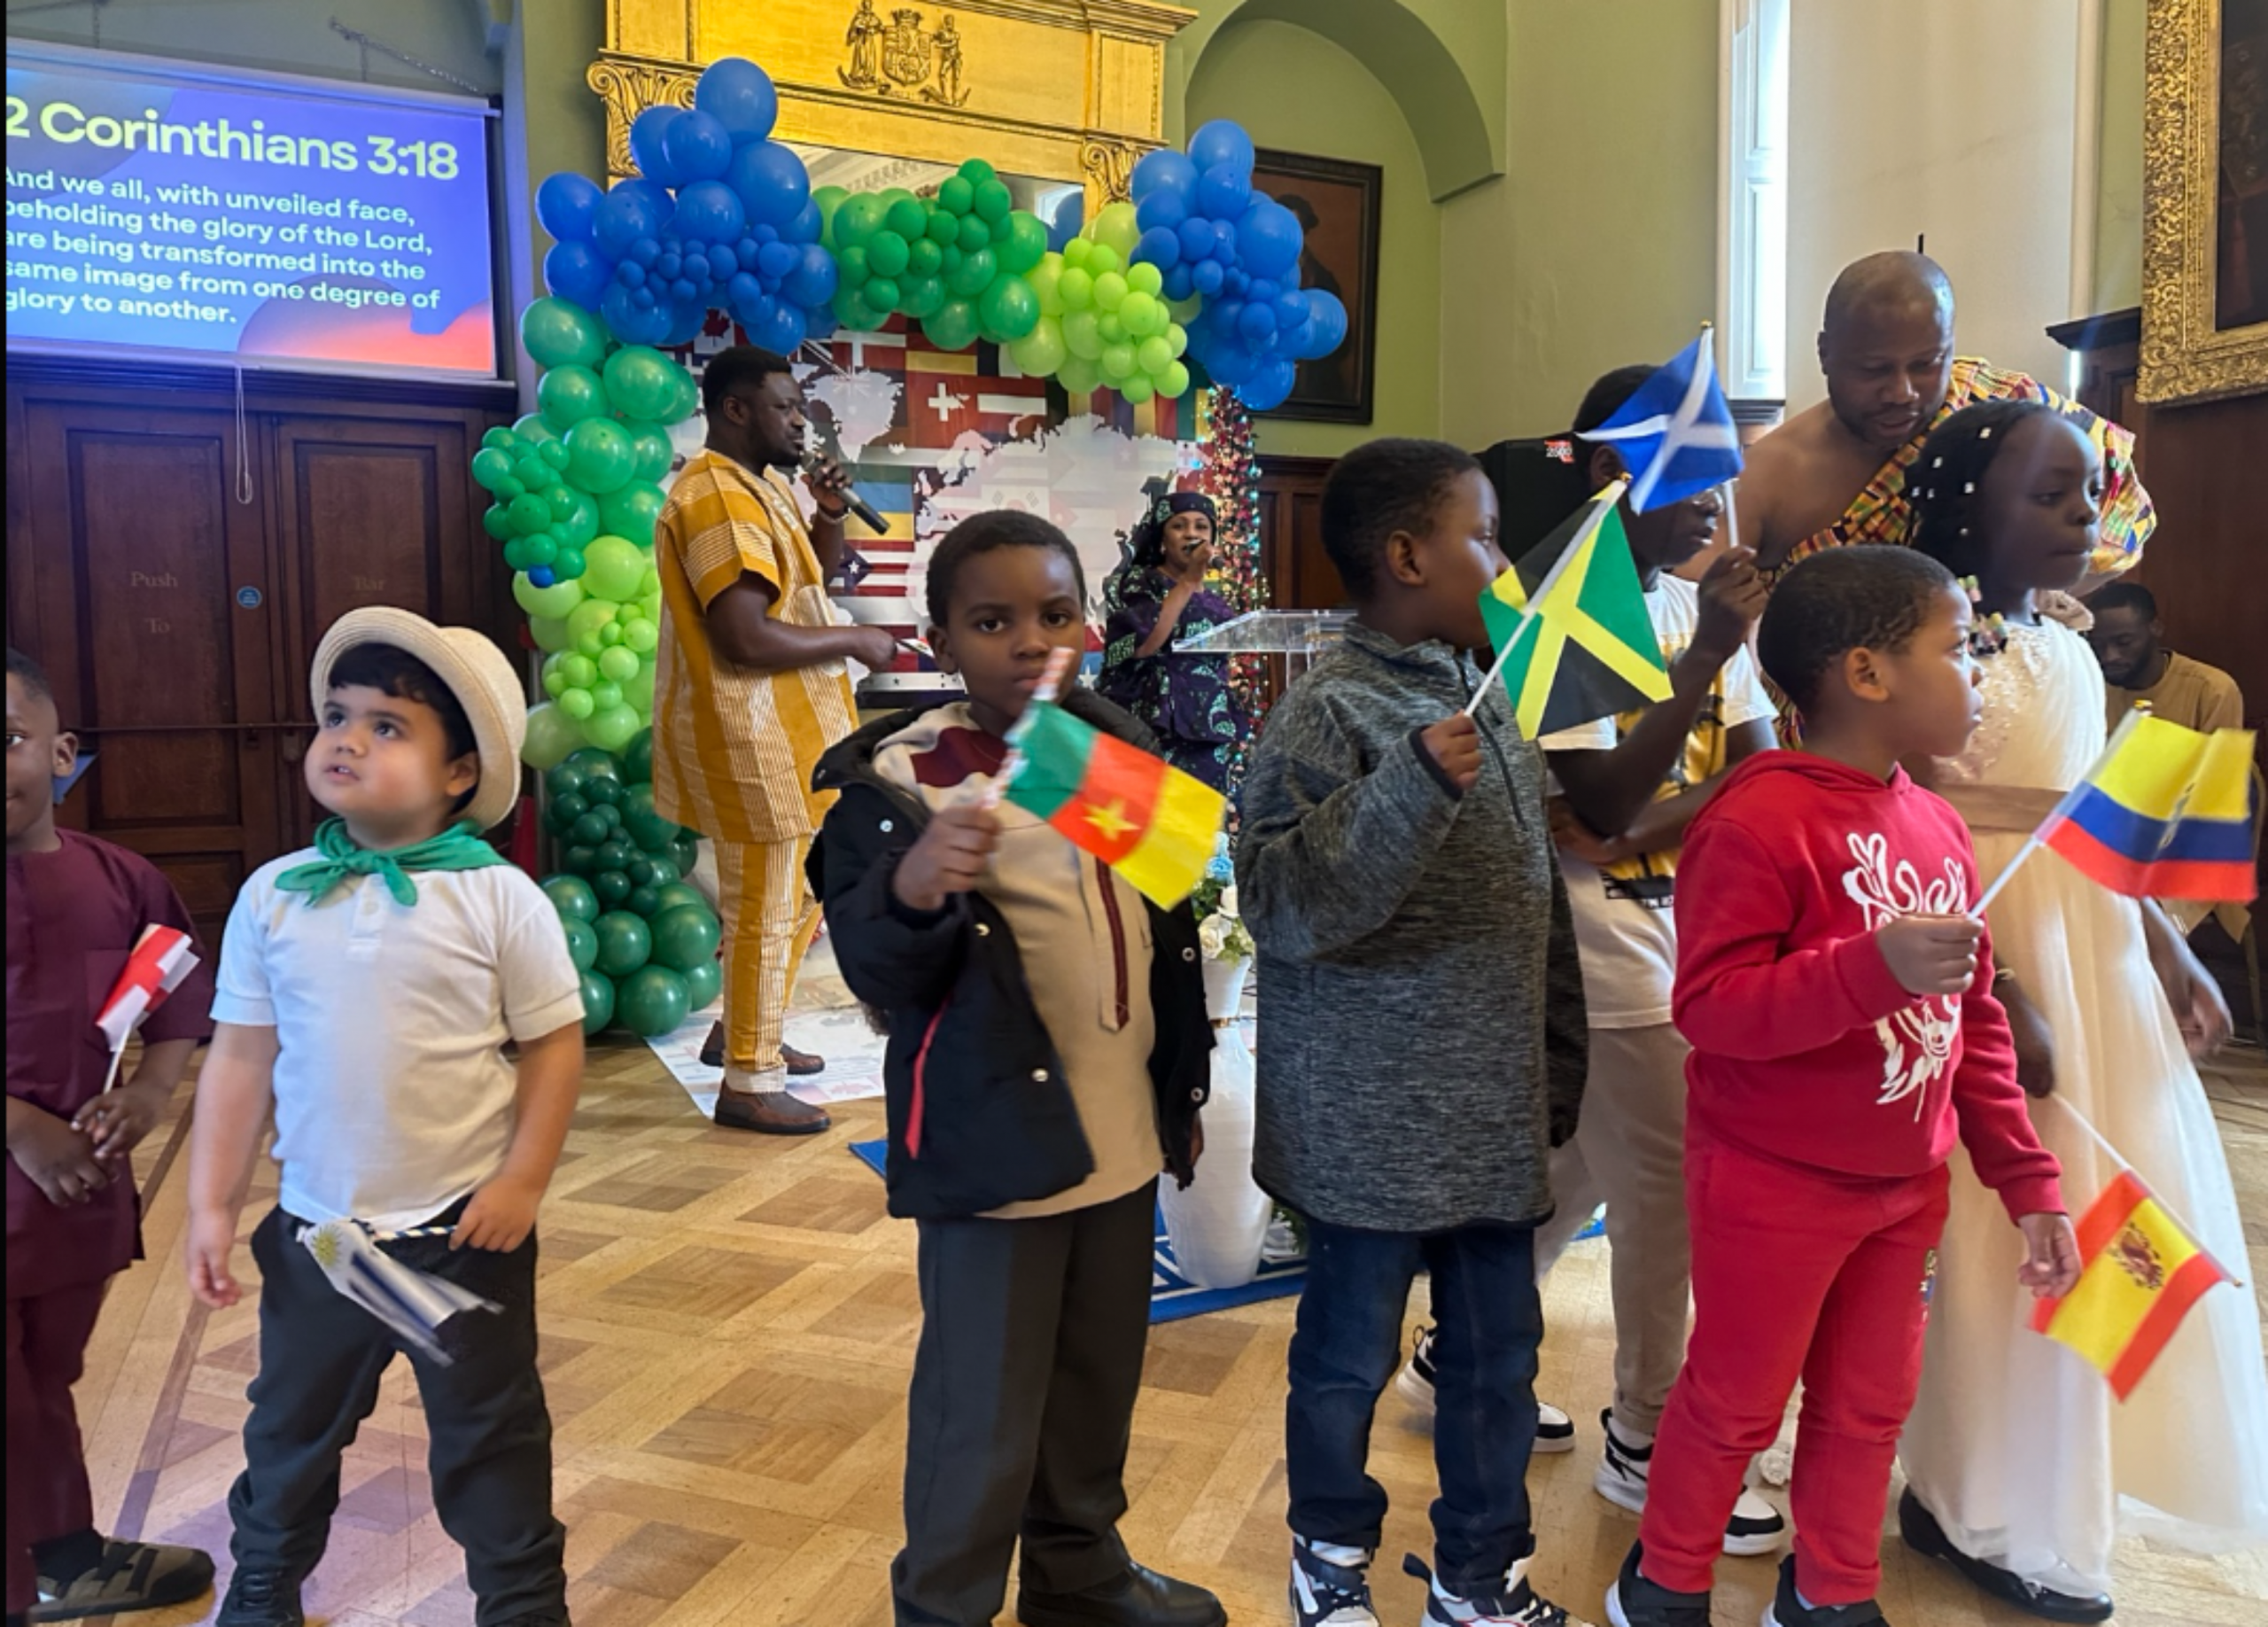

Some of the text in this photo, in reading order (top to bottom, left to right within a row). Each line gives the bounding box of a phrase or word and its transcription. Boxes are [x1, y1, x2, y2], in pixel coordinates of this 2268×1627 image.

[6, 96, 459, 180] 2 Corinthians 3:18
[61, 175, 104, 195] we
[111, 179, 151, 205] all,
[156, 183, 219, 206] with
[226, 192, 341, 218] unveiled
[347, 199, 415, 227] face,
[52, 230, 133, 262] being
[140, 240, 315, 273] transformed
[322, 253, 375, 276] into
[380, 260, 425, 280] the
[149, 212, 197, 234] the
[203, 217, 273, 244] glory
[279, 223, 308, 244] of
[313, 225, 359, 247] the
[365, 230, 432, 255] Lord,
[6, 287, 237, 324] glory to another.
[84, 263, 173, 293] image
[179, 270, 247, 296] from
[252, 282, 304, 300] one
[310, 282, 407, 309] degree
[412, 290, 440, 309] of
[131, 571, 178, 588] Push
[143, 617, 171, 634] To
